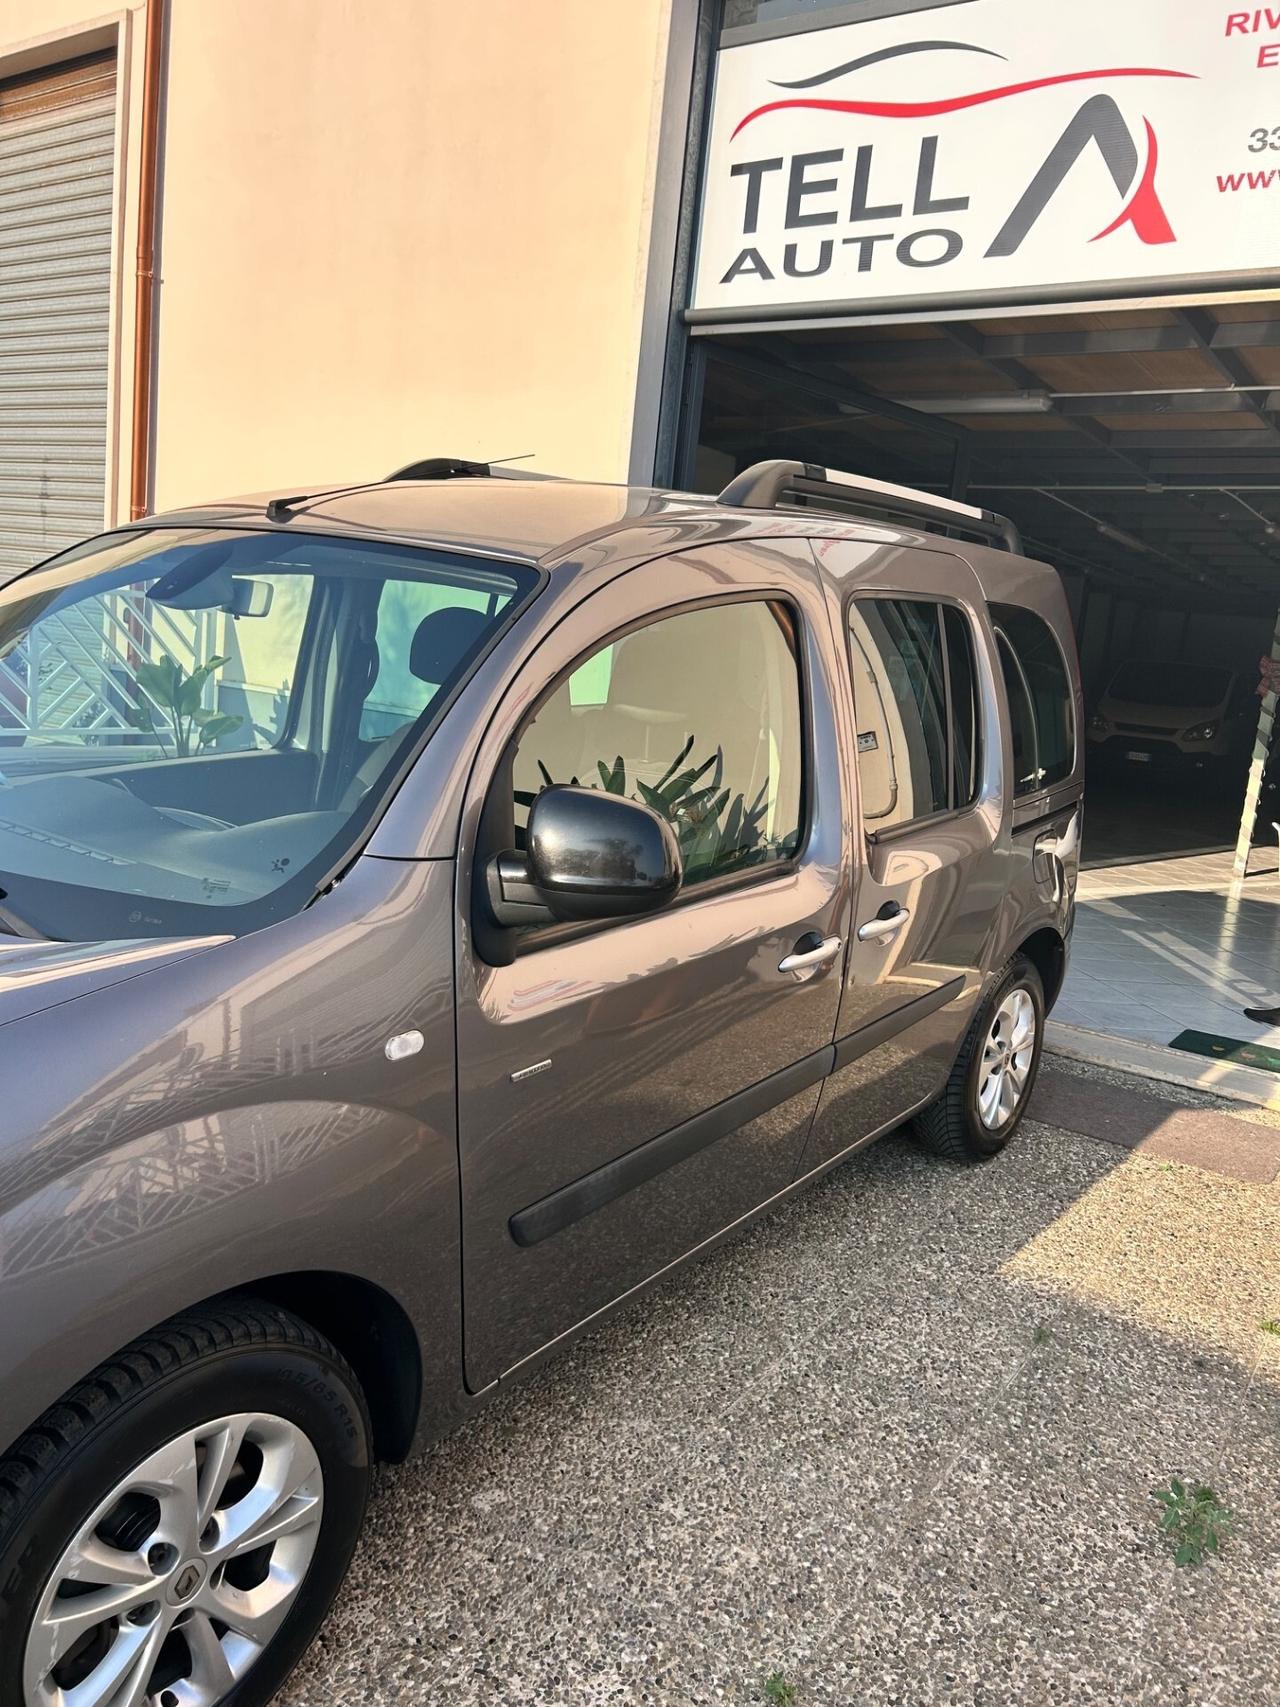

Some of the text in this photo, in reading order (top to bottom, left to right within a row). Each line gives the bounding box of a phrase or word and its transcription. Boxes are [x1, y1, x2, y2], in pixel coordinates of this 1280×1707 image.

[730, 135, 970, 234] TELL
[1216, 168, 1280, 193] ww
[719, 228, 963, 284] AUTO
